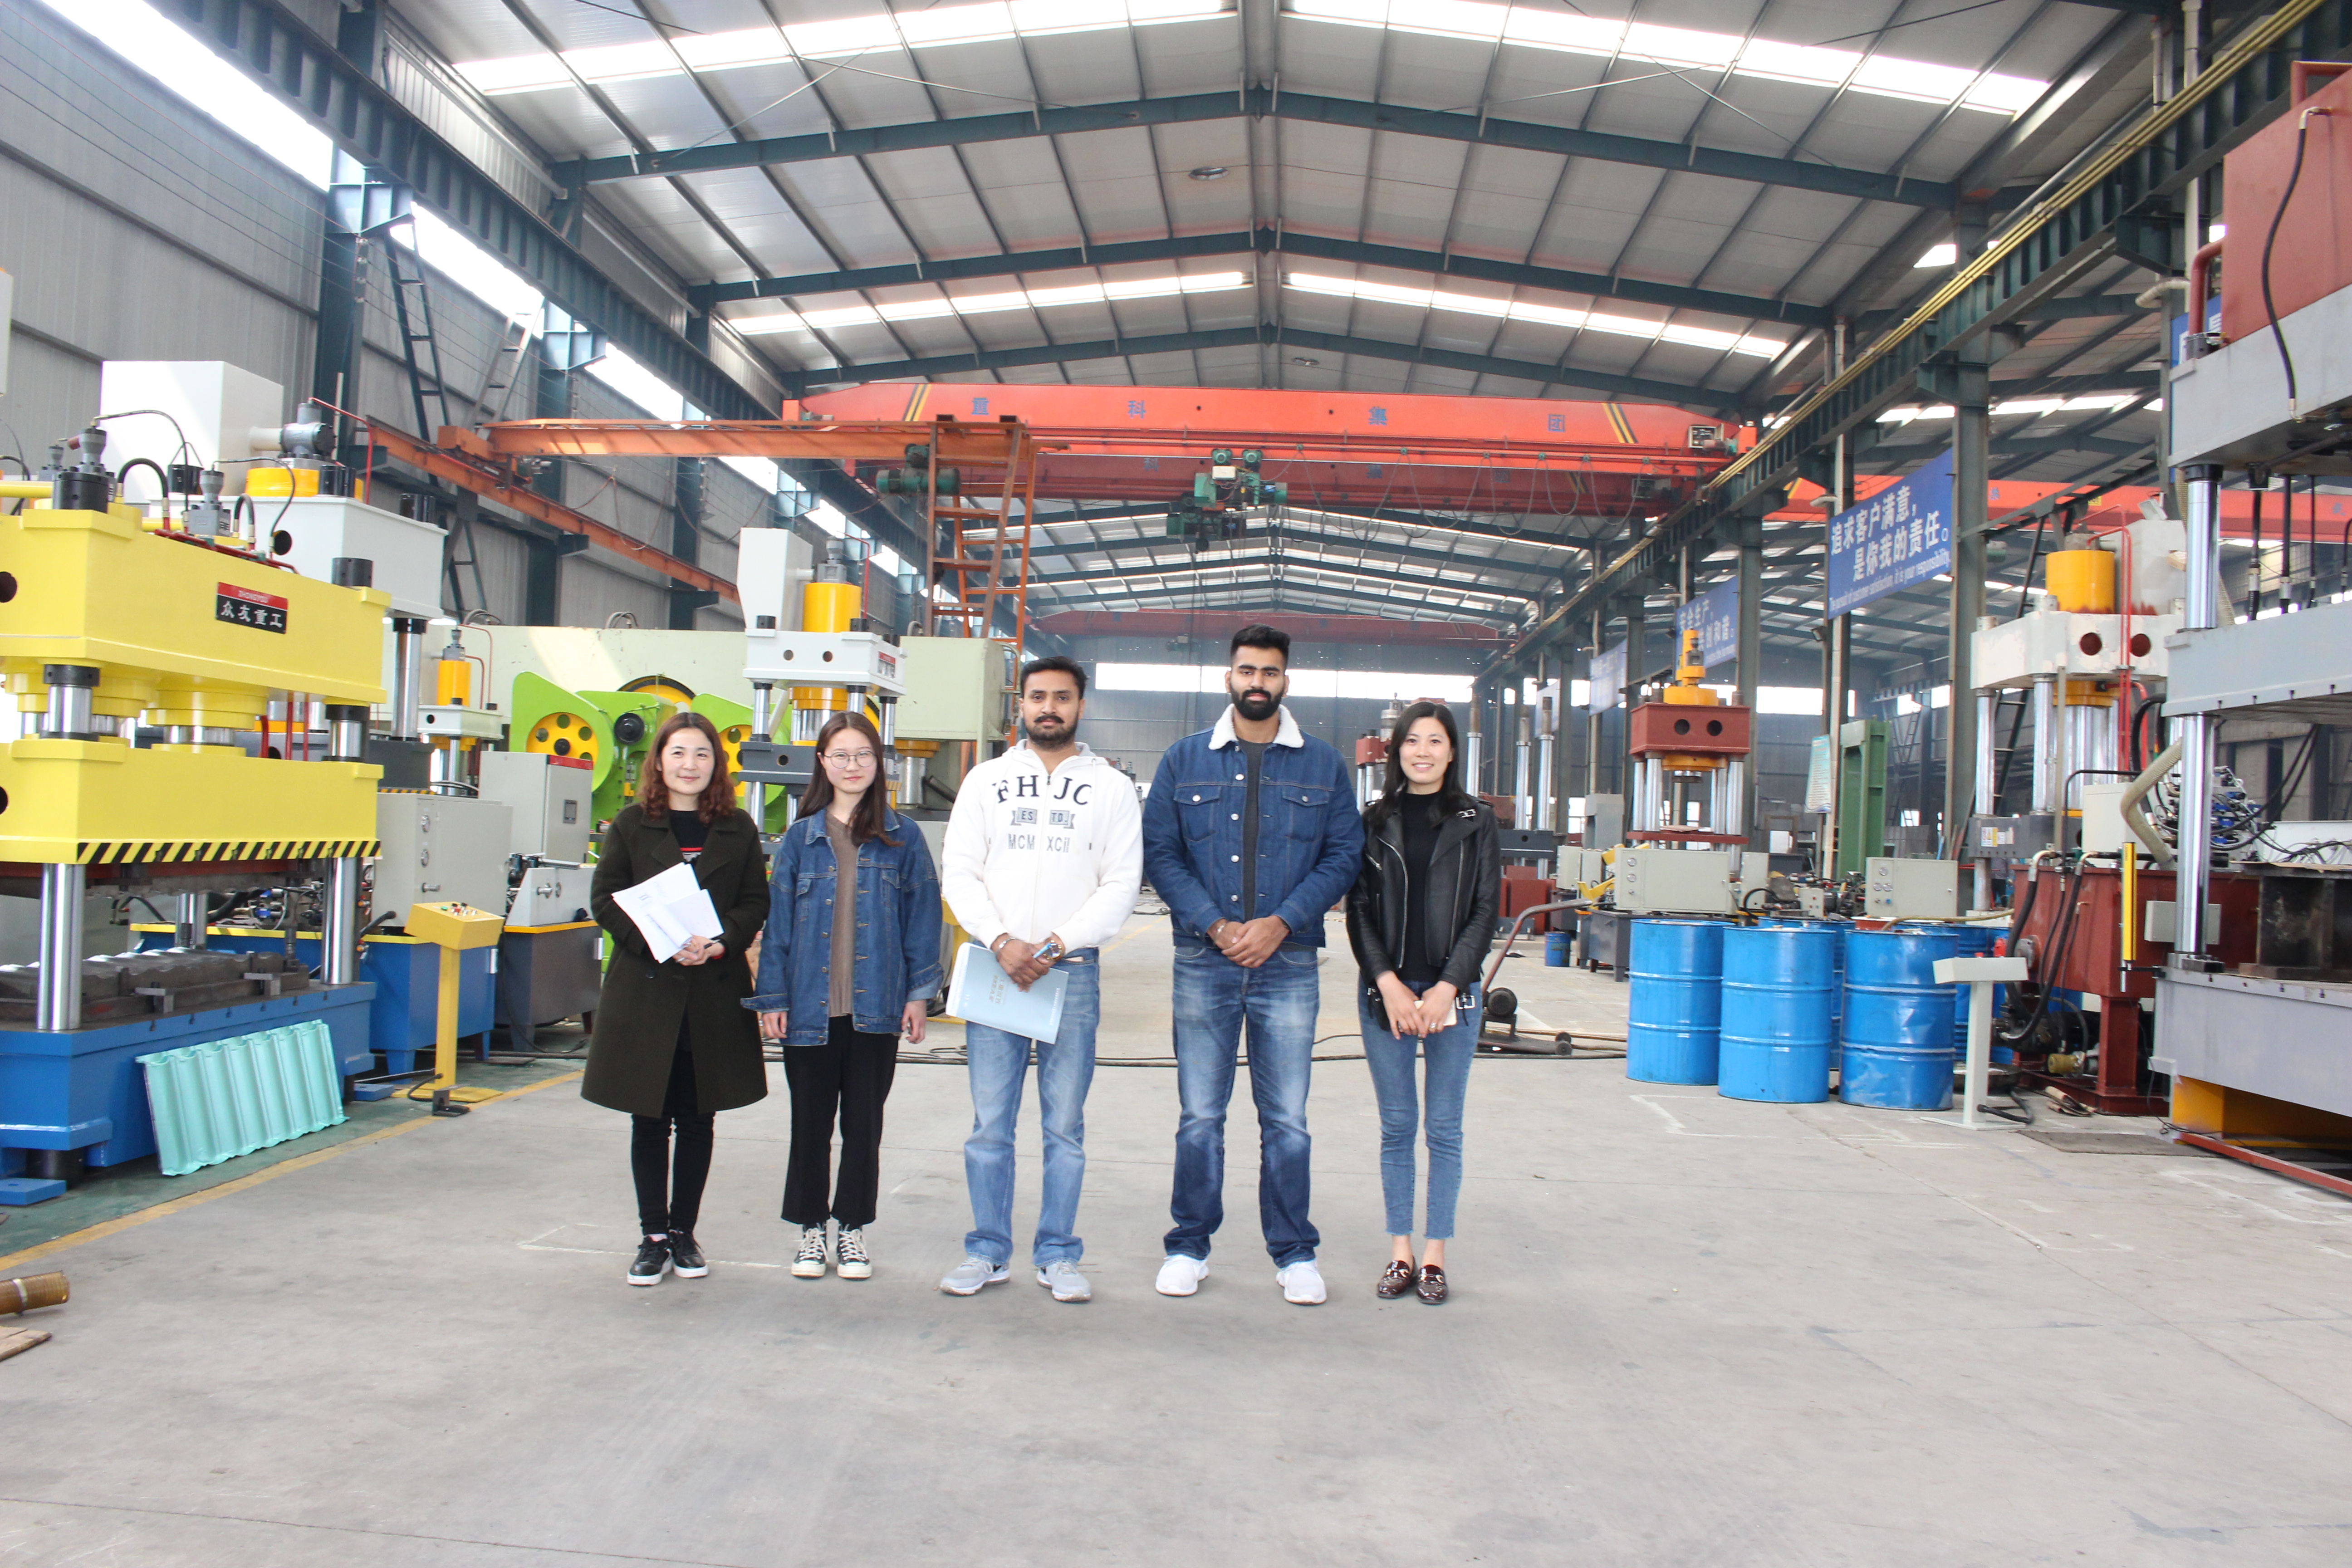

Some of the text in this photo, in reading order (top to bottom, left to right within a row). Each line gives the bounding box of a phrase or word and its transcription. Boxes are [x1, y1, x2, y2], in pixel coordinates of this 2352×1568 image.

[971, 397, 1566, 432] 重 科 集 团
[220, 600, 283, 628] 众友重工
